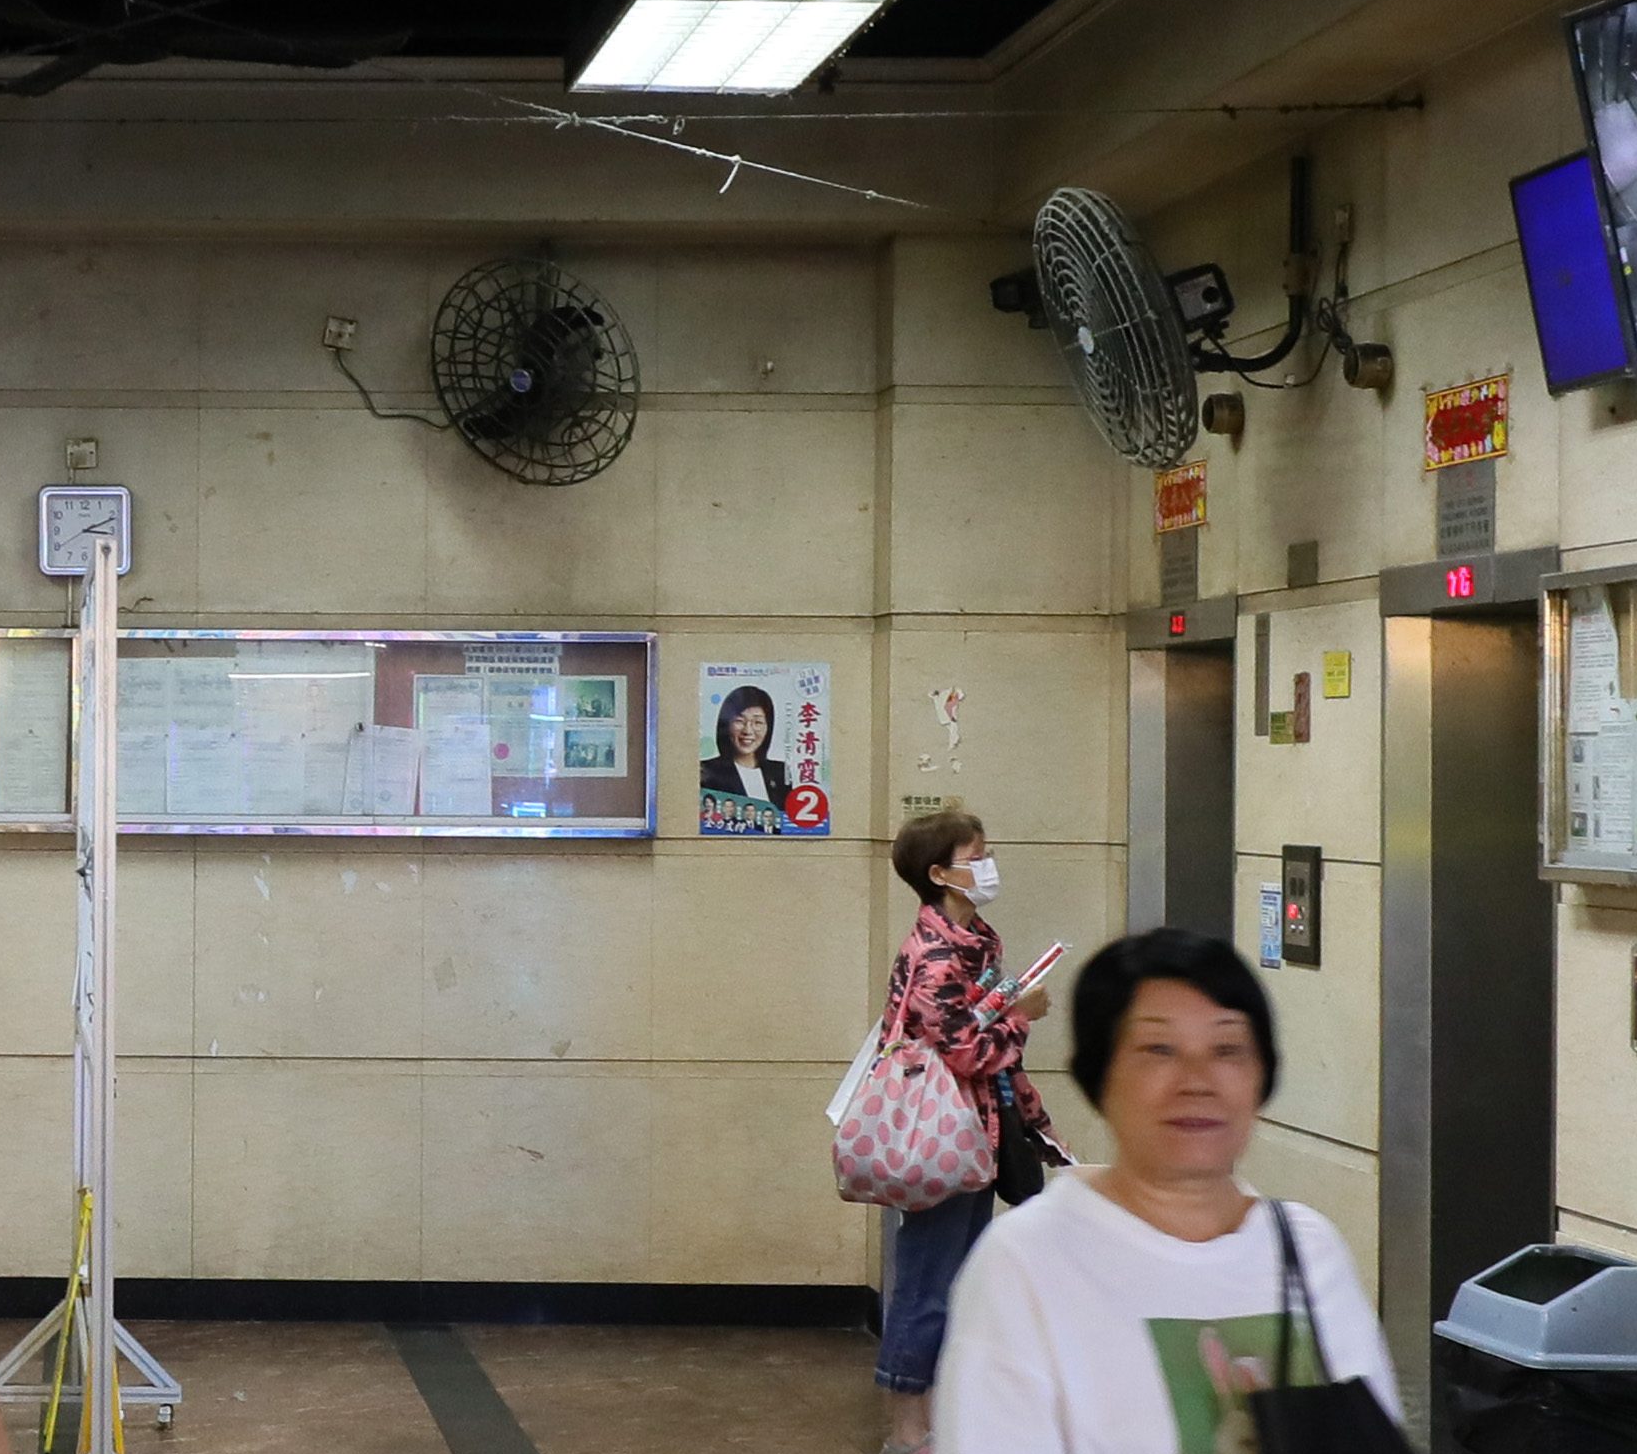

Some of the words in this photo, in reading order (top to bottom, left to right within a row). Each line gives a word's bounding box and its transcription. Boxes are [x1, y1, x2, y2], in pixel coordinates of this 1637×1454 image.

[65, 501, 73, 510] 11
[79, 501, 90, 510] 12
[97, 501, 102, 510] 1
[53, 510, 64, 520] 10
[53, 526, 60, 535] 9
[67, 551, 73, 560] 7
[81, 552, 88, 561] 6
[796, 702, 821, 784] 李清霞
[795, 790, 820, 821] 2
